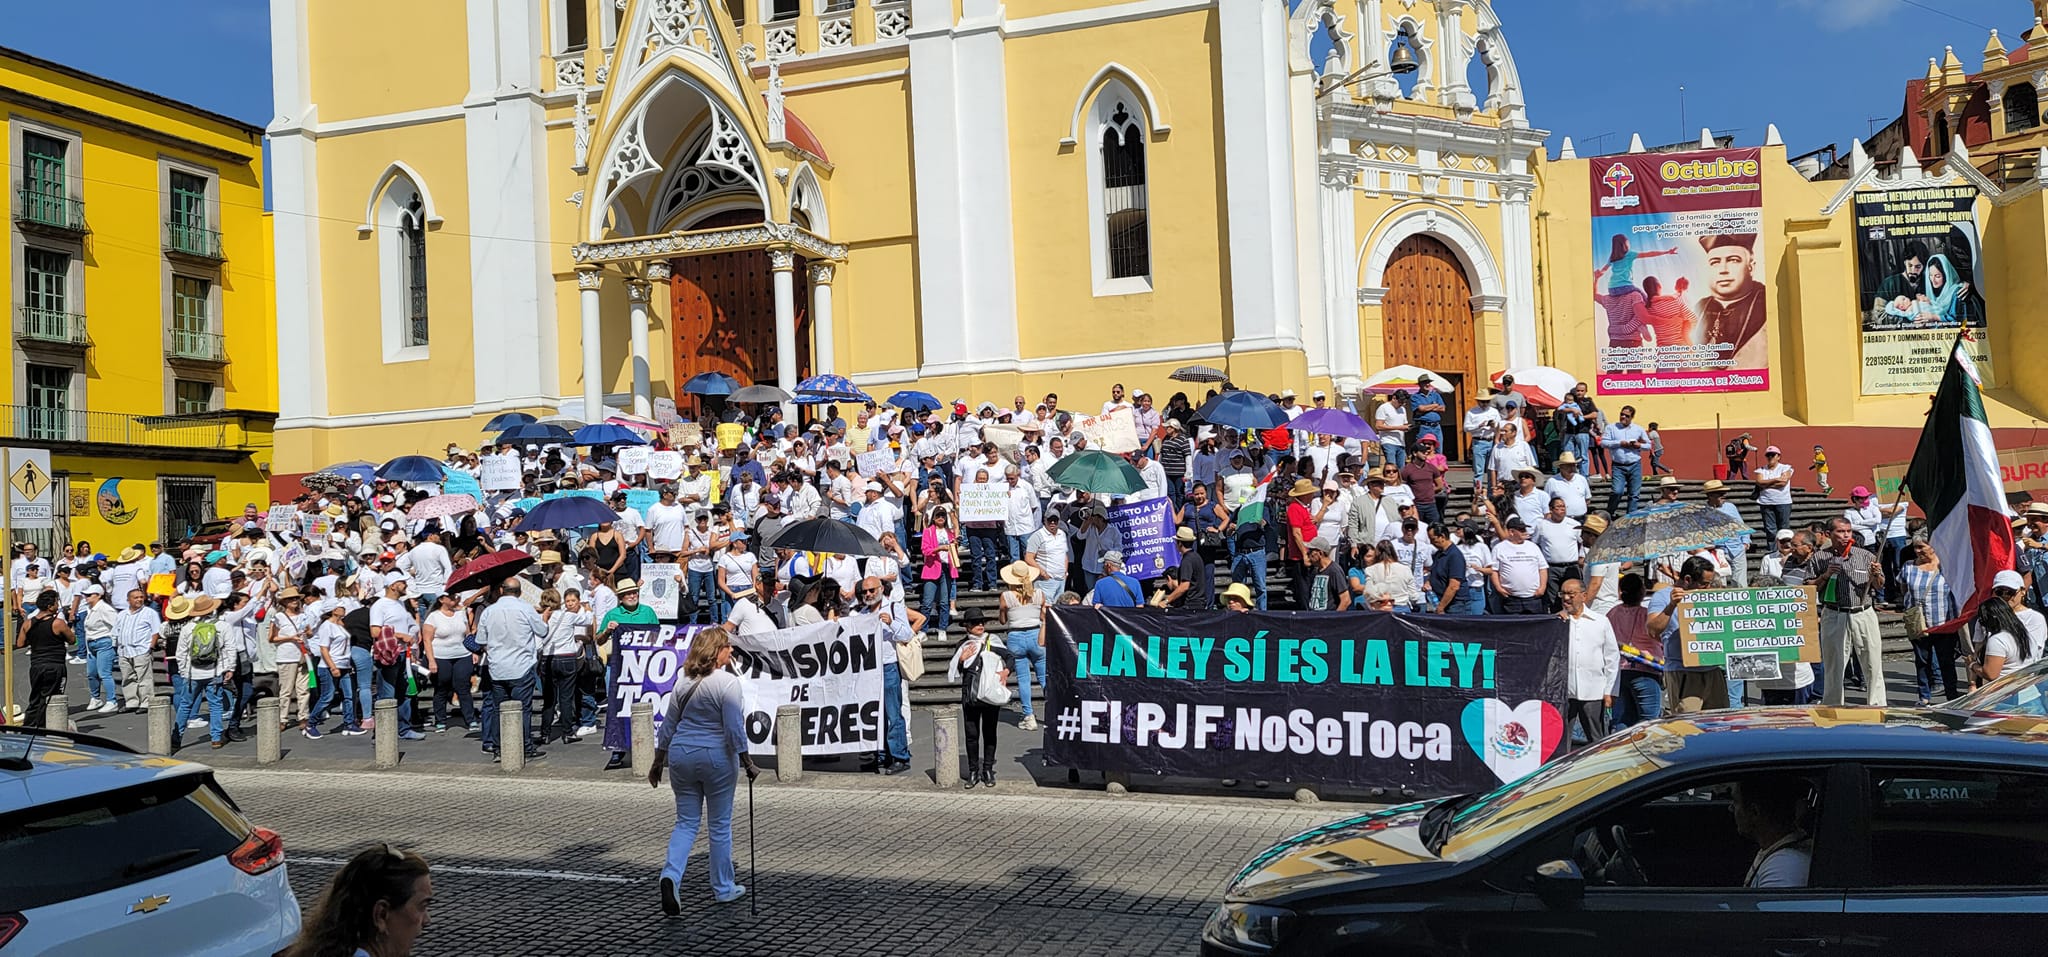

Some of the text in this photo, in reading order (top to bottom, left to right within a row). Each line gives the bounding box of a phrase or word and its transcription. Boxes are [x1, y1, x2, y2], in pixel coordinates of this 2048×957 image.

[1661, 158, 1758, 181] Octubre
[1889, 189, 1945, 201] METROPOLITANA
[1946, 189, 1955, 197] DE
[1896, 214, 1904, 224] DE
[1905, 211, 1947, 223] SUPERACIÓN
[1712, 220, 1729, 228] algo
[1731, 220, 1744, 228] que
[1694, 228, 1722, 236] detiene
[1892, 334, 1896, 342] Y
[1937, 332, 1943, 340] DE
[1609, 346, 1629, 354] Señor
[1630, 347, 1652, 355] quiere
[1707, 343, 1733, 351] familia
[1692, 351, 1719, 359] recinto
[1911, 347, 1942, 355] INFORMES
[1616, 361, 1651, 369] humaniza
[1152, 502, 1163, 511] LA
[1151, 513, 1164, 523] DE
[1122, 527, 1158, 540] ODERES
[1141, 536, 1174, 546] NOSOTROS
[1683, 591, 1750, 602] POBRECITO
[1686, 603, 1808, 617] TAN LEJOS DE DIOS
[1689, 619, 1802, 631] Y TAN CERCA DE
[620, 630, 652, 647] #EL
[1690, 636, 1804, 651] OTRA DICTADURA
[1076, 630, 1498, 689] ¡LA LEY SÍ ES LA LEY!
[617, 650, 677, 684] NO
[790, 684, 809, 702] DE
